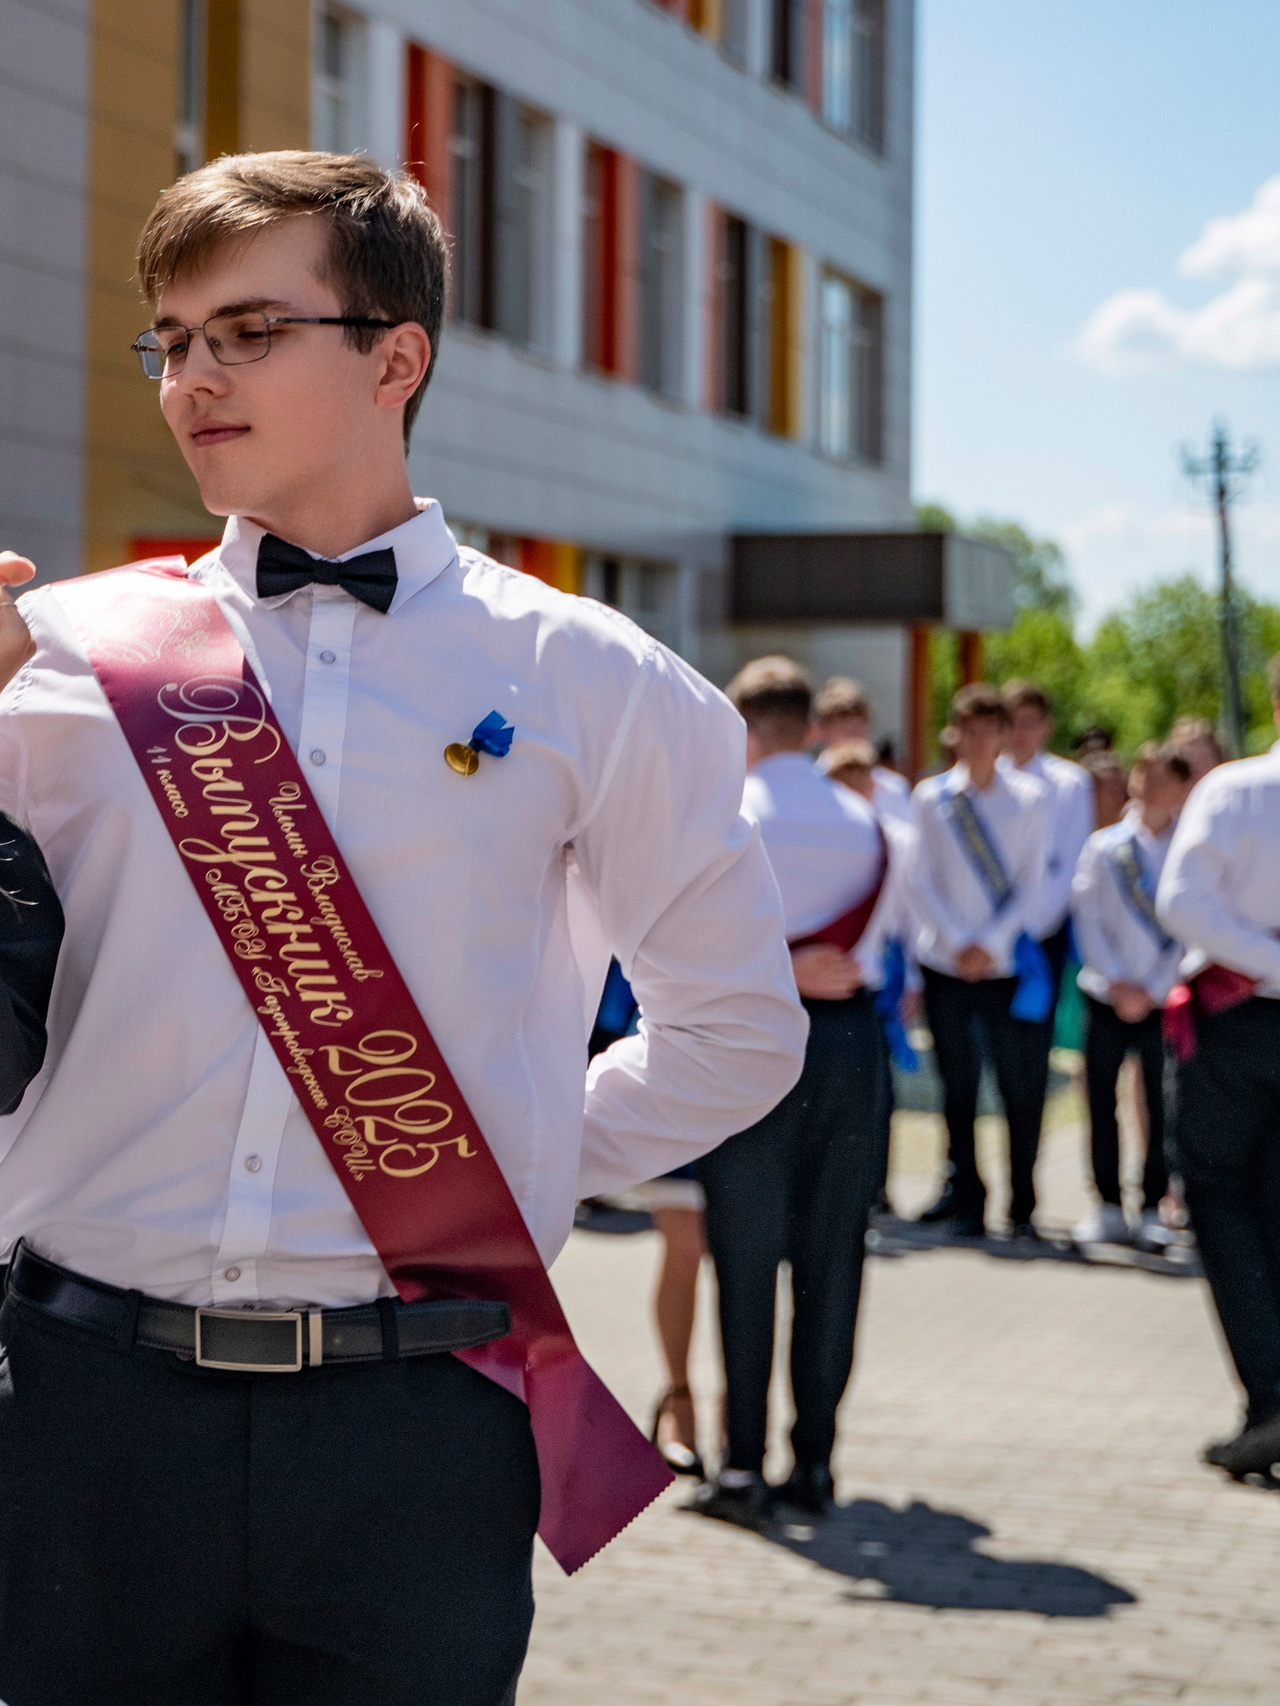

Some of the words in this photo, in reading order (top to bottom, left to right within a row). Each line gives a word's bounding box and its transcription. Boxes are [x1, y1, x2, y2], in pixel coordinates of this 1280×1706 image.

[146, 745, 172, 764] 11
[156, 769, 189, 818] класс
[157, 674, 353, 1027] Выпускник
[318, 1029, 478, 1178] 2025
[205, 868, 272, 960] МБОУ
[268, 781, 308, 858] Ильин
[300, 854, 384, 982] Владислав
